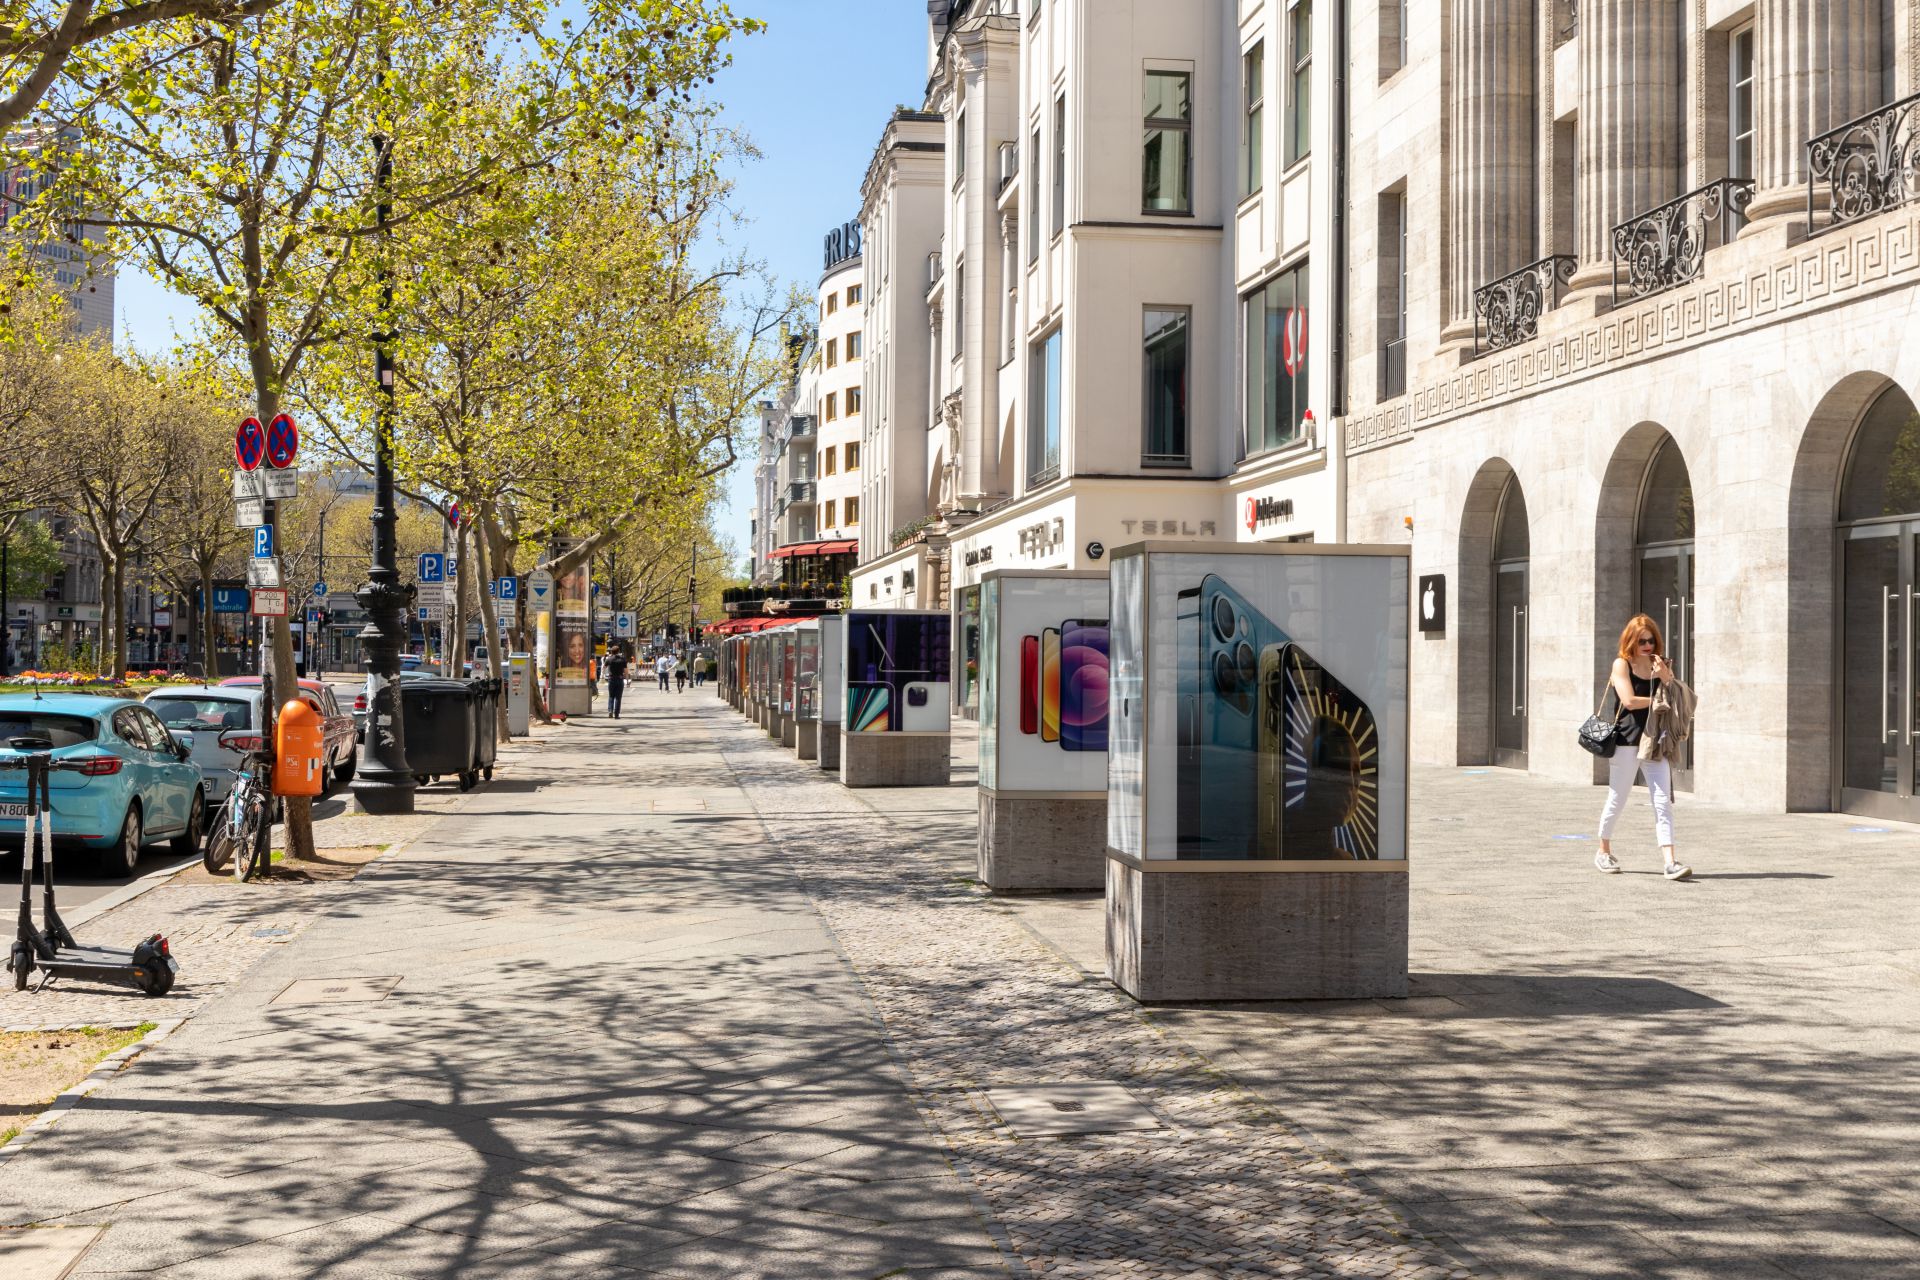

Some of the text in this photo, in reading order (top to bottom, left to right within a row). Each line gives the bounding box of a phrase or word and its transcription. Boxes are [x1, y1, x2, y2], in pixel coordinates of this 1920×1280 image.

[823, 219, 860, 270] BRIS
[1018, 516, 1064, 557] TESLA
[1121, 520, 1216, 536] TESLA
[257, 529, 268, 554] P
[425, 556, 437, 578] P
[448, 560, 456, 574] P
[218, 591, 229, 603] U
[502, 579, 512, 597] P
